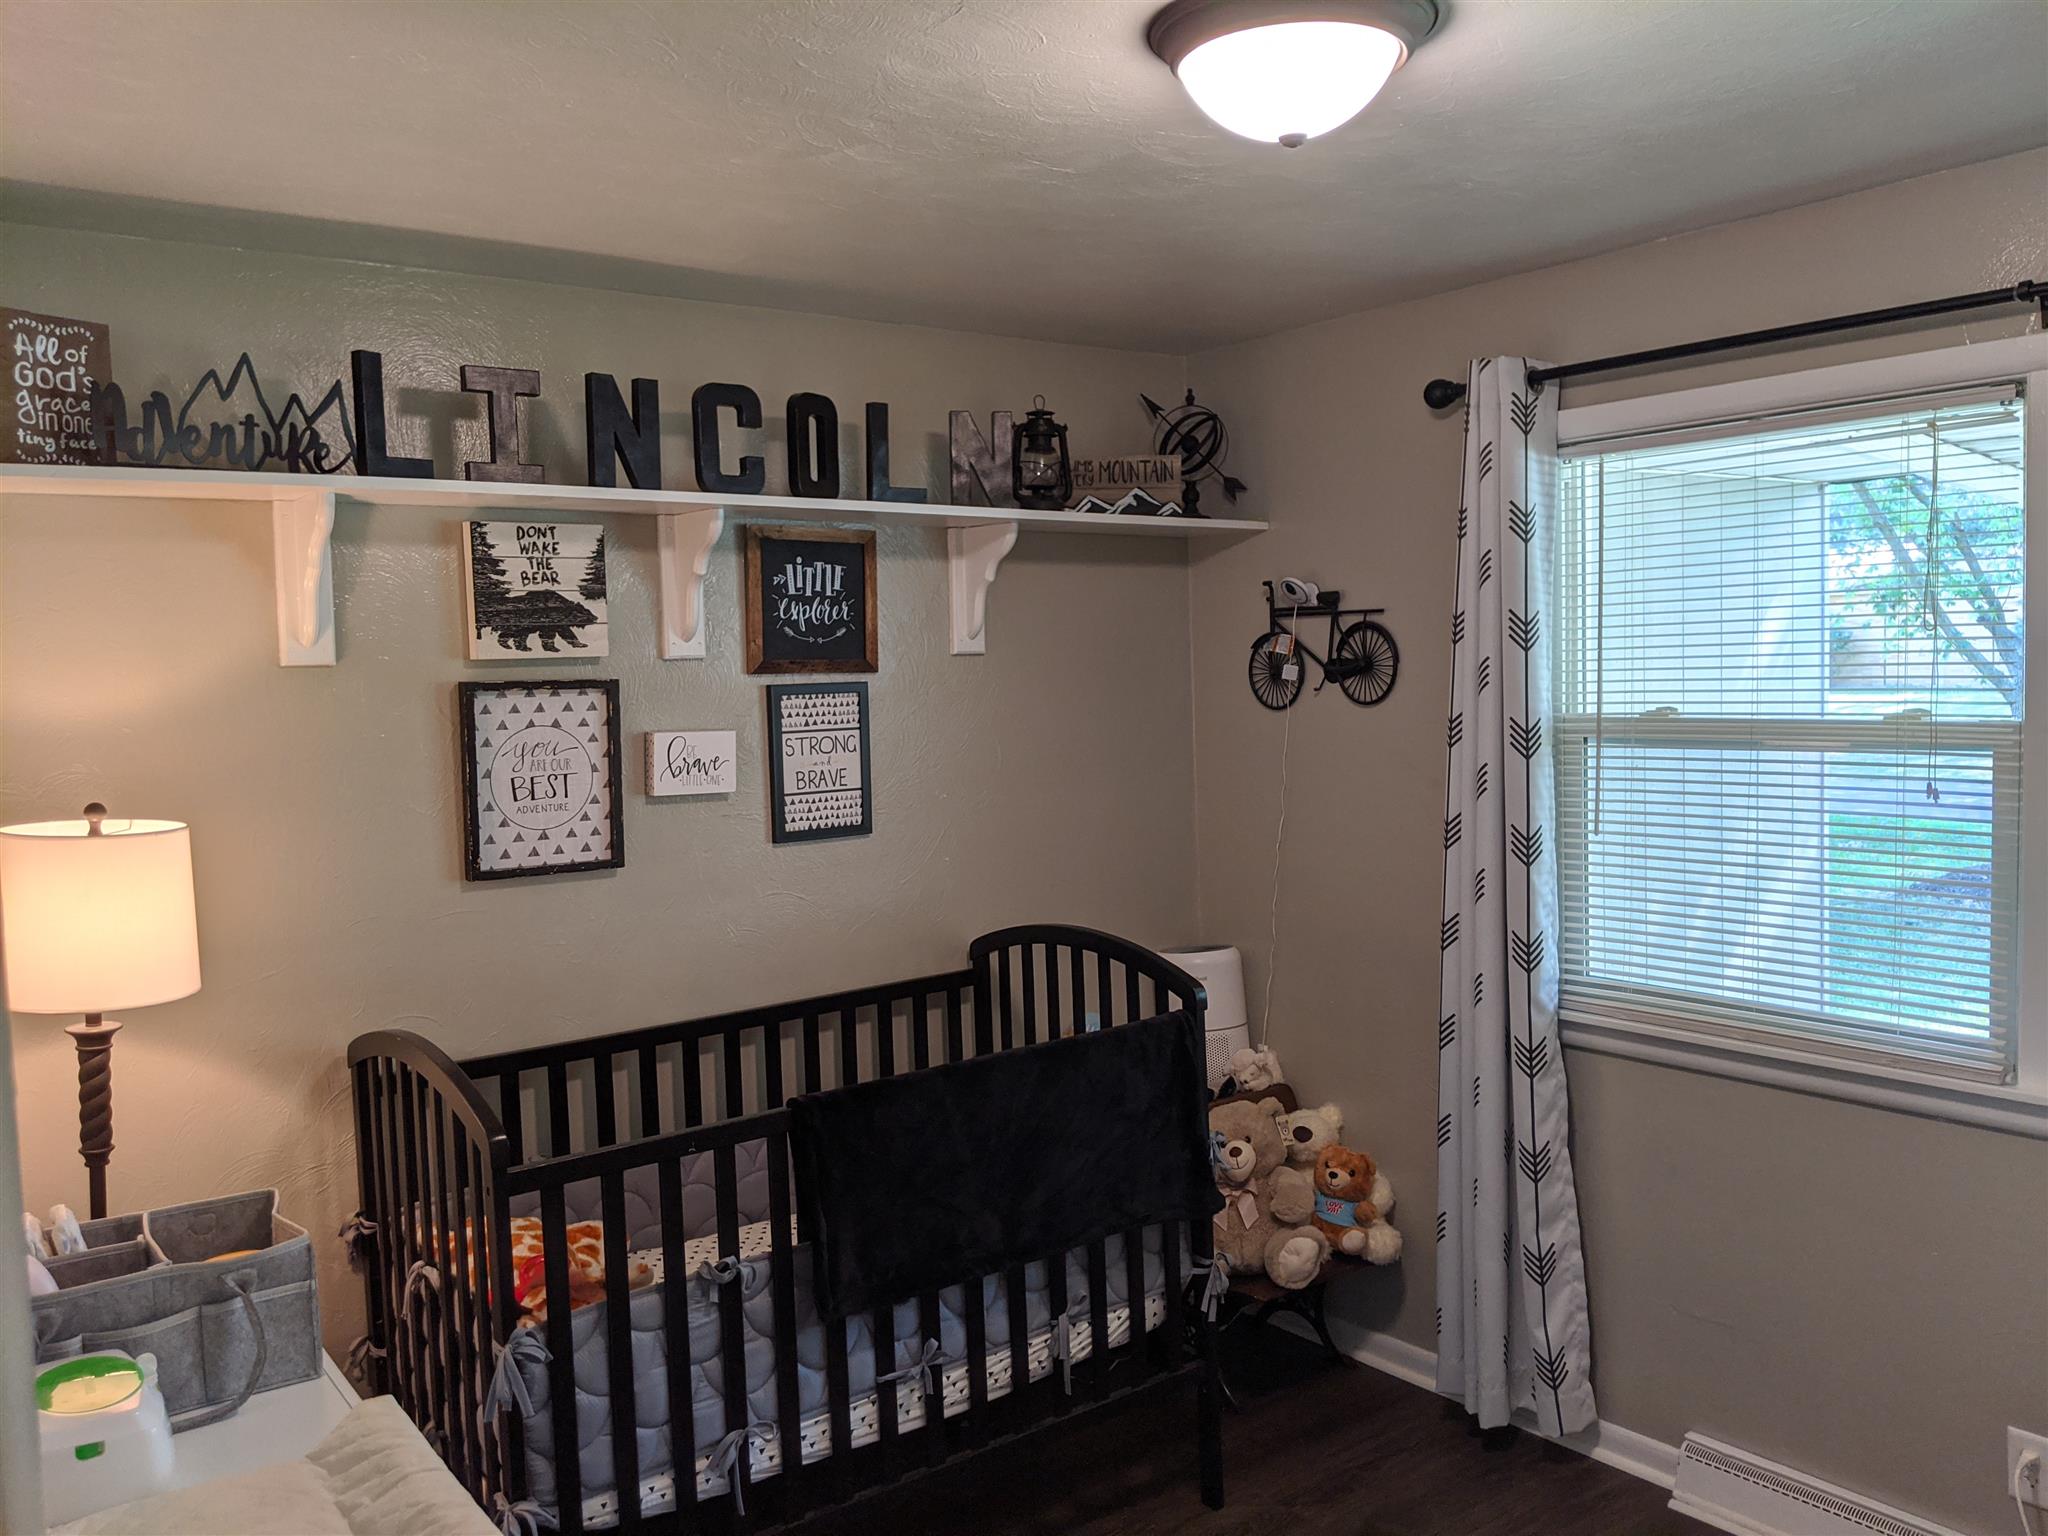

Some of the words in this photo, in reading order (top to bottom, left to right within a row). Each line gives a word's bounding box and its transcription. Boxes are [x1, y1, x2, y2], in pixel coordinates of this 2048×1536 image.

[14, 332, 62, 365] All
[64, 345, 89, 365] of
[14, 361, 94, 394] God's
[16, 389, 91, 425] grace
[38, 412, 59, 432] in
[62, 415, 94, 435] one
[351, 349, 1013, 509] LINCOLN
[16, 428, 57, 453] tiny
[59, 433, 97, 451] face
[1099, 460, 1174, 485] MOUNTAIN
[516, 525, 557, 541] DON'T
[519, 541, 561, 557] WAKE
[526, 556, 554, 571] THE
[520, 570, 561, 587] BEAR
[779, 597, 851, 632] explorer
[501, 739, 579, 773] you
[785, 734, 857, 758] STRONG
[550, 757, 573, 772] OUR
[660, 735, 730, 783] brave
[812, 756, 832, 767] and
[510, 771, 579, 802] BEST
[795, 767, 849, 791] BRAVE
[516, 802, 571, 815] ADVENTURE
